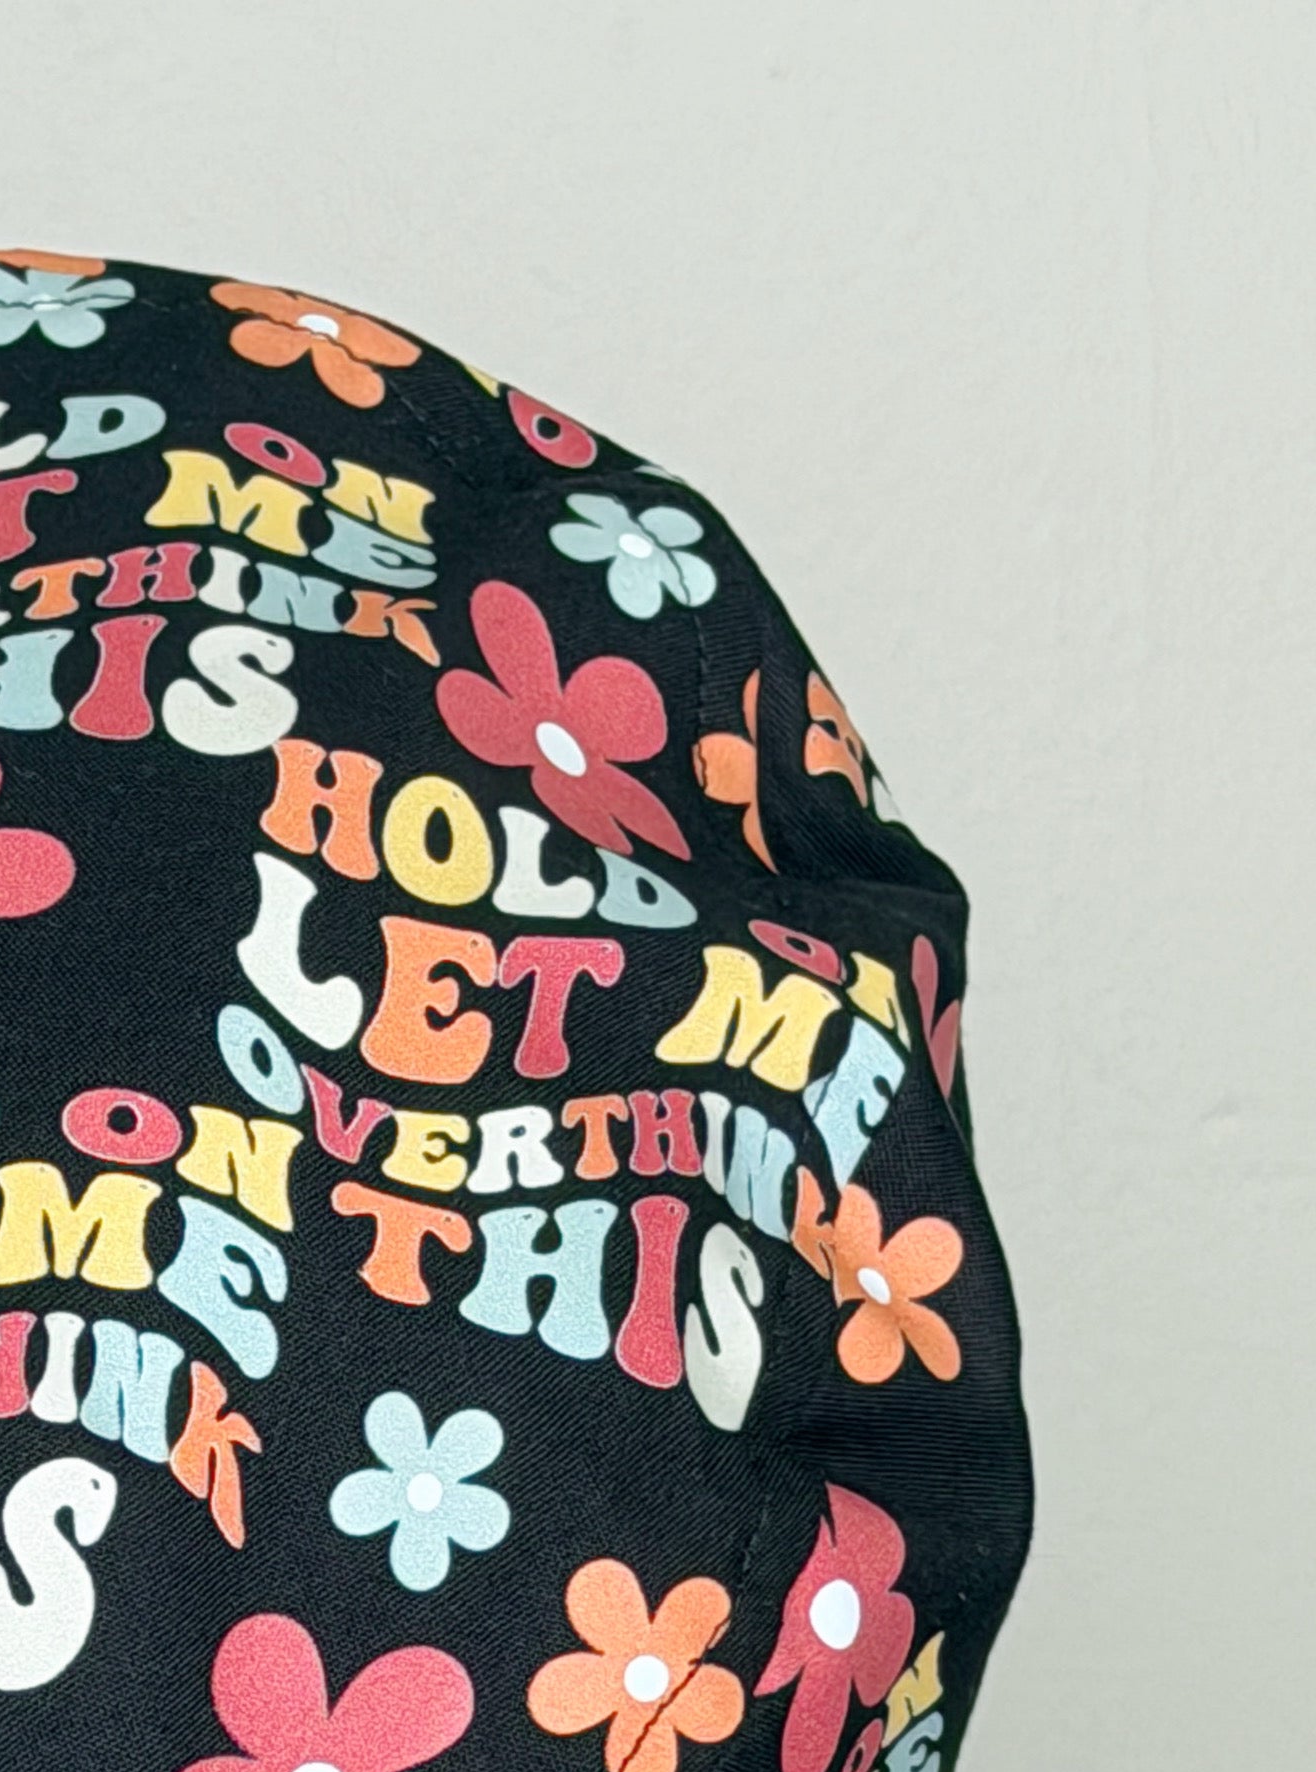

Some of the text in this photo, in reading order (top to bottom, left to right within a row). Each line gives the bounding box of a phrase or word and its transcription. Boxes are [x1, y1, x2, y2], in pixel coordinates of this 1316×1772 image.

[145, 450, 437, 588] ME
[224, 423, 436, 544] ON
[260, 739, 911, 1053] HOLD ON
[236, 852, 906, 1189] LET ME
[62, 1087, 303, 1232] ON
[330, 1181, 764, 1432] THIS
